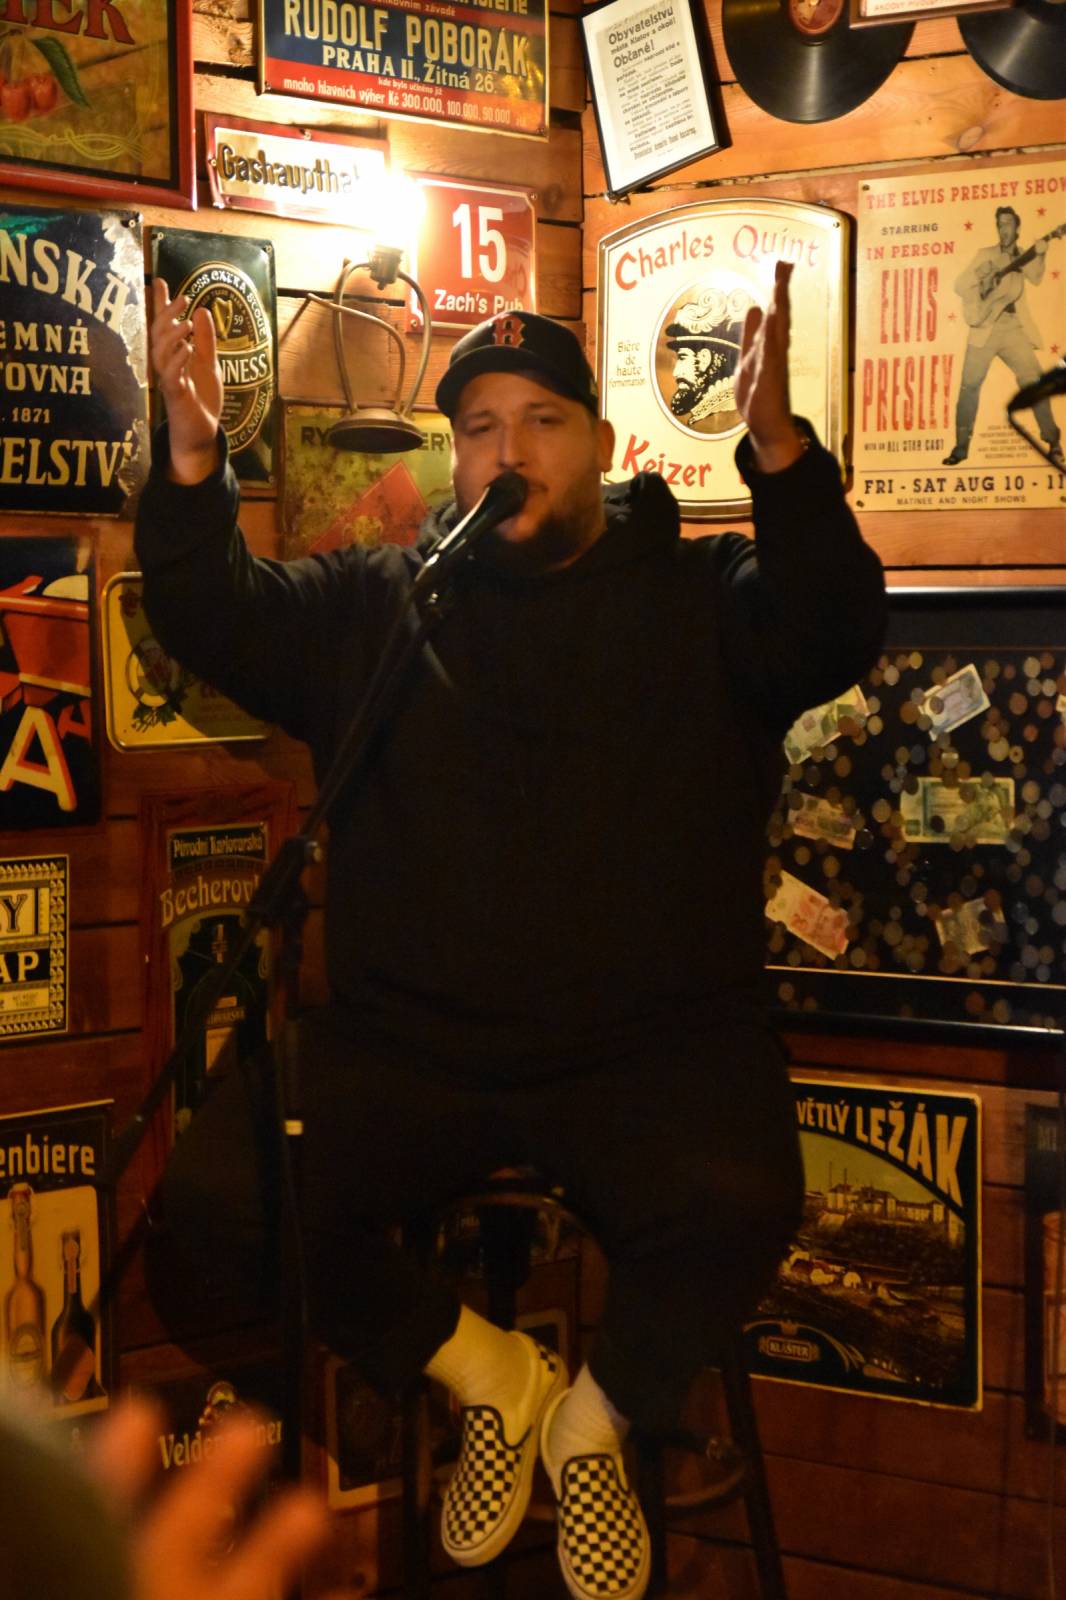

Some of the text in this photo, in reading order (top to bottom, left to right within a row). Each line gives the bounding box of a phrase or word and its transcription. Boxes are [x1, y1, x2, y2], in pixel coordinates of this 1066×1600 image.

[284, 0, 529, 77] RUDOLF POBORÁK
[608, 6, 675, 45] Obyvatelstvu
[322, 45, 396, 77] PRAHA
[423, 59, 470, 90] Žitná
[613, 38, 655, 69] Občané!
[283, 78, 315, 93] mnoho
[317, 80, 357, 100] hlavních
[359, 87, 386, 105] výher
[388, 90, 400, 106] Kč
[865, 191, 897, 210] THE
[901, 188, 945, 207] ELVIS
[951, 180, 1019, 203] PRESLEY
[452, 203, 507, 283] 15
[881, 222, 939, 236] STARRING
[614, 223, 822, 291] Charles Quint
[866, 241, 956, 261] IN PERSON
[434, 289, 524, 314] Zach's Pub
[879, 266, 939, 345] ELVIS
[491, 313, 527, 348] B
[0, 361, 92, 396] OVNA
[616, 363, 642, 377] haute
[861, 353, 954, 433] PRESLEY
[12, 407, 51, 424] 1871
[621, 434, 712, 488] Keizer
[864, 479, 894, 494] FRI
[912, 477, 948, 494] SAT
[954, 476, 995, 493] AUG
[1004, 475, 1025, 492] 10
[896, 494, 1027, 506] MATINEE AND NIGHT SHOWS
[854, 1100, 969, 1208] LEŽÁK
